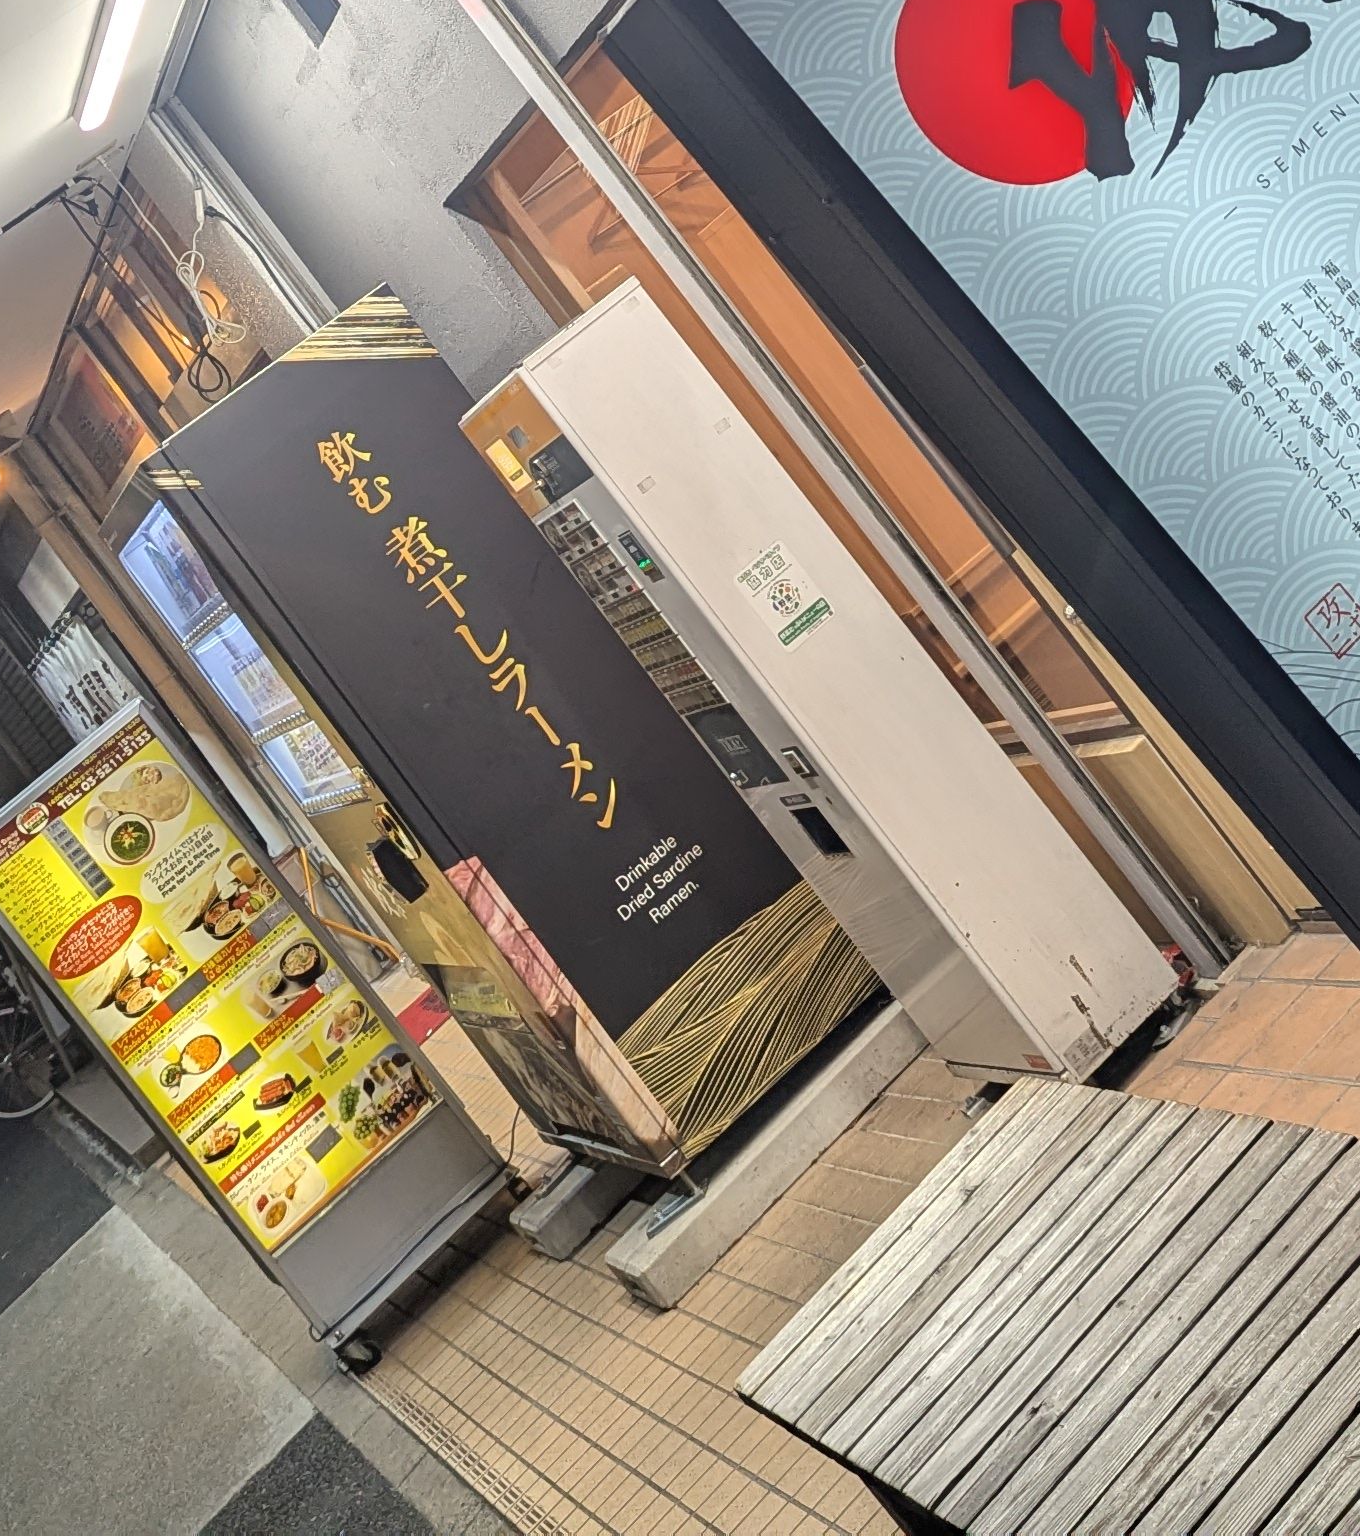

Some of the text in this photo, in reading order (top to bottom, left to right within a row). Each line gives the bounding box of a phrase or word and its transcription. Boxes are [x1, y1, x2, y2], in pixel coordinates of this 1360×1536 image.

[317, 431, 616, 829] 飲む 煮干しラーメン
[615, 836, 677, 892] Drinkable
[616, 844, 703, 922] Dried Sardine
[648, 881, 700, 924] Ramen.
